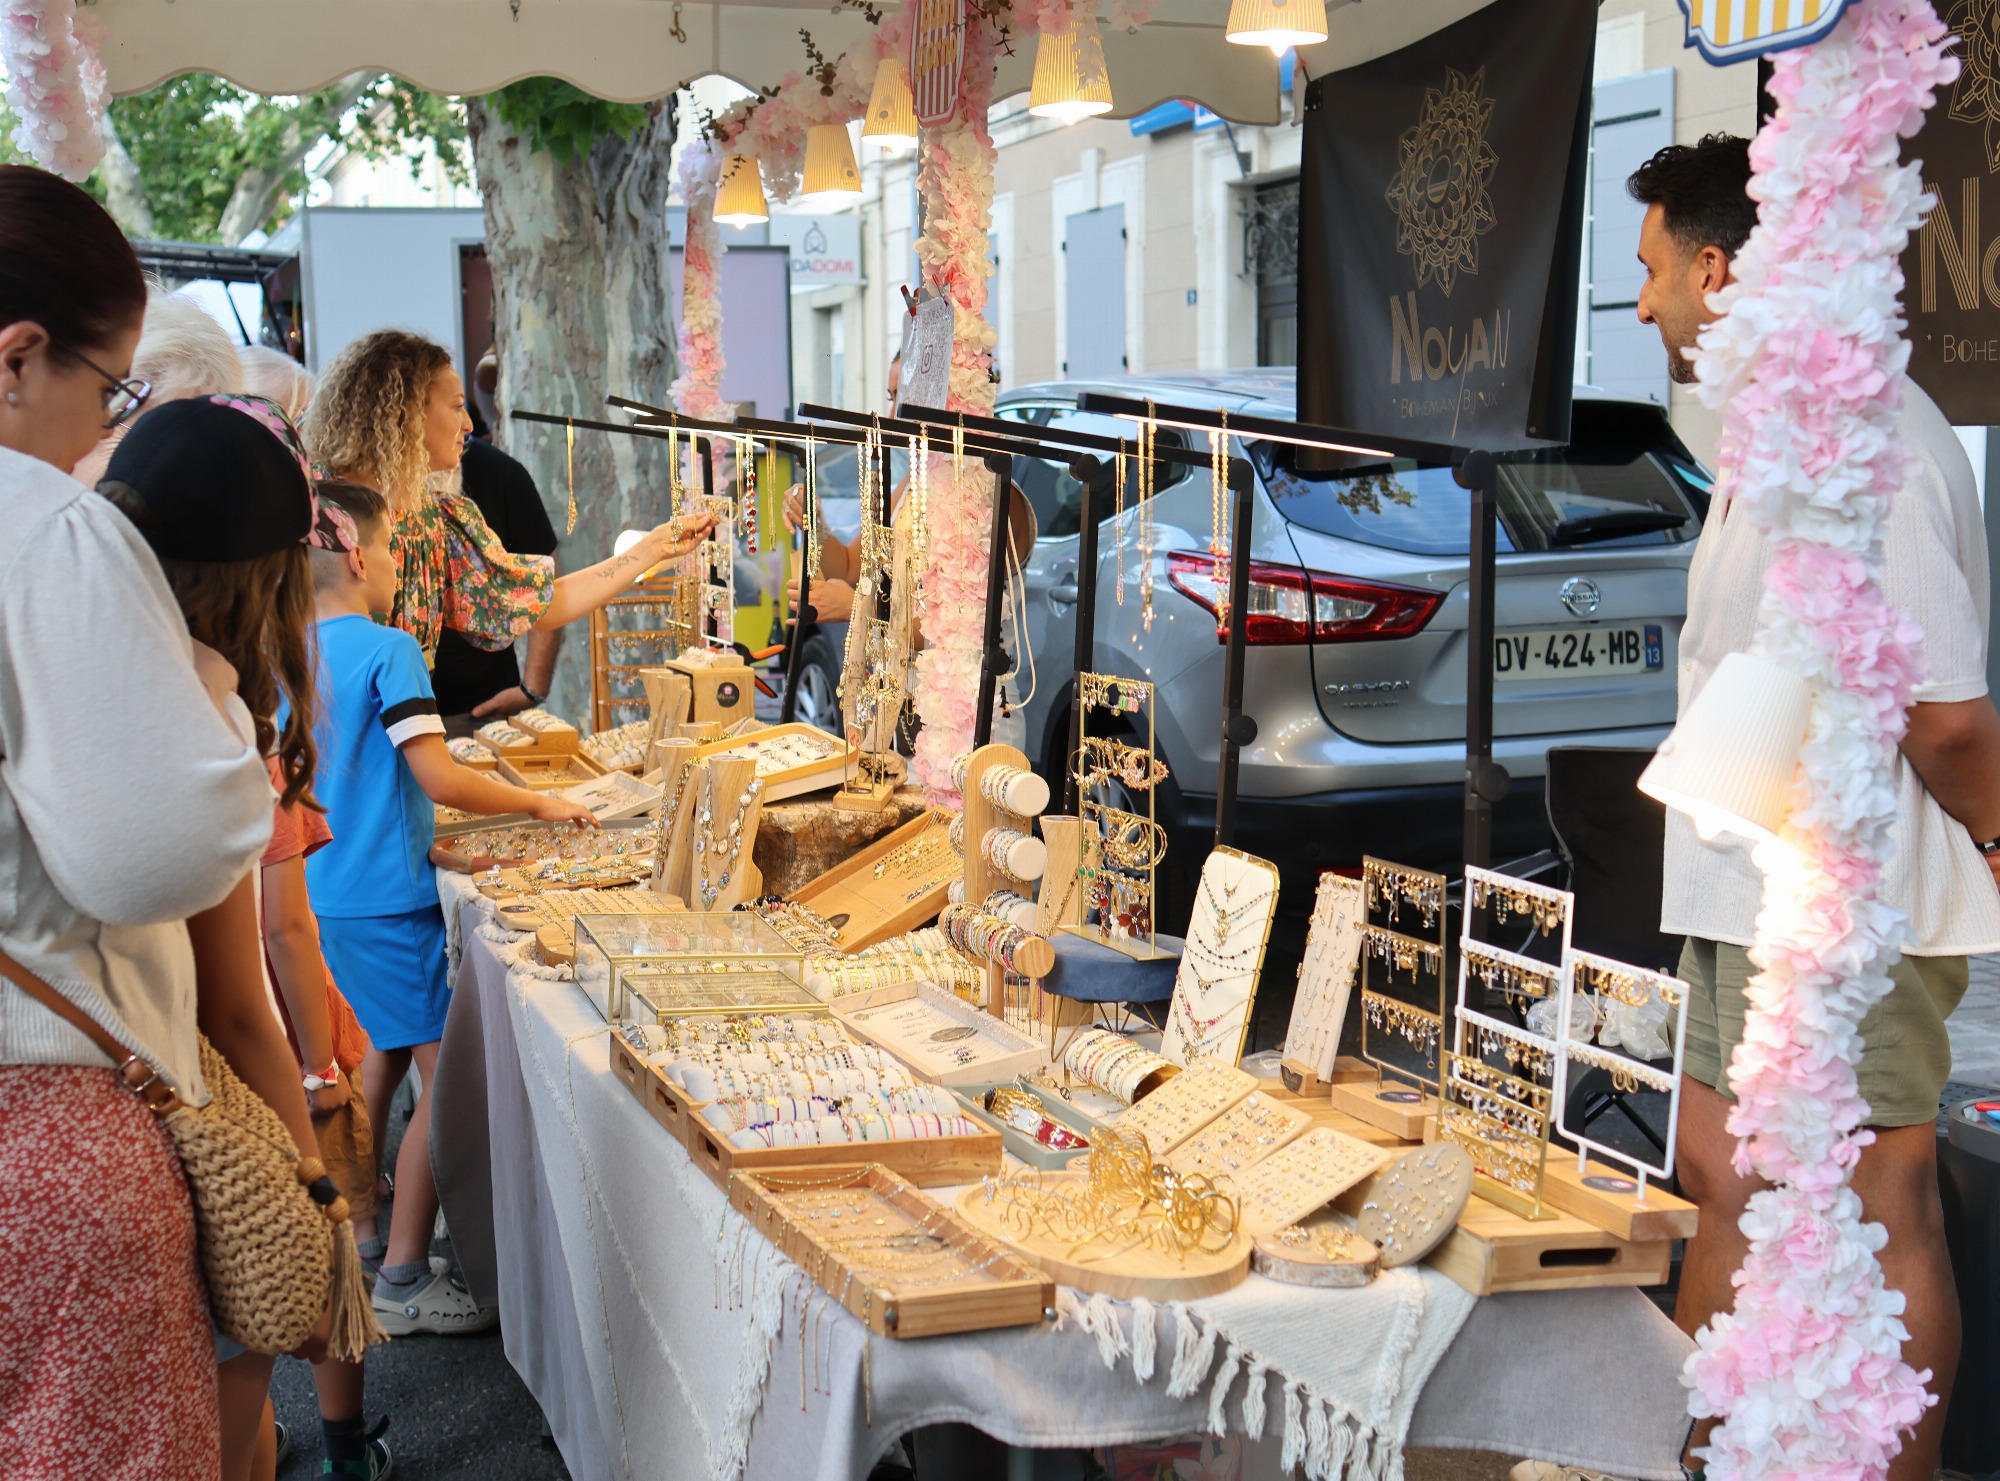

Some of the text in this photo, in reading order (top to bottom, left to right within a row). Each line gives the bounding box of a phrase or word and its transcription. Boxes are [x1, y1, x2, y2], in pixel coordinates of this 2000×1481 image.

[1943, 334, 2000, 363] BOHE
[1568, 593, 1599, 602] NISSAN
[1495, 630, 1641, 672] DV-424-MB
[1647, 648, 1661, 664] 13
